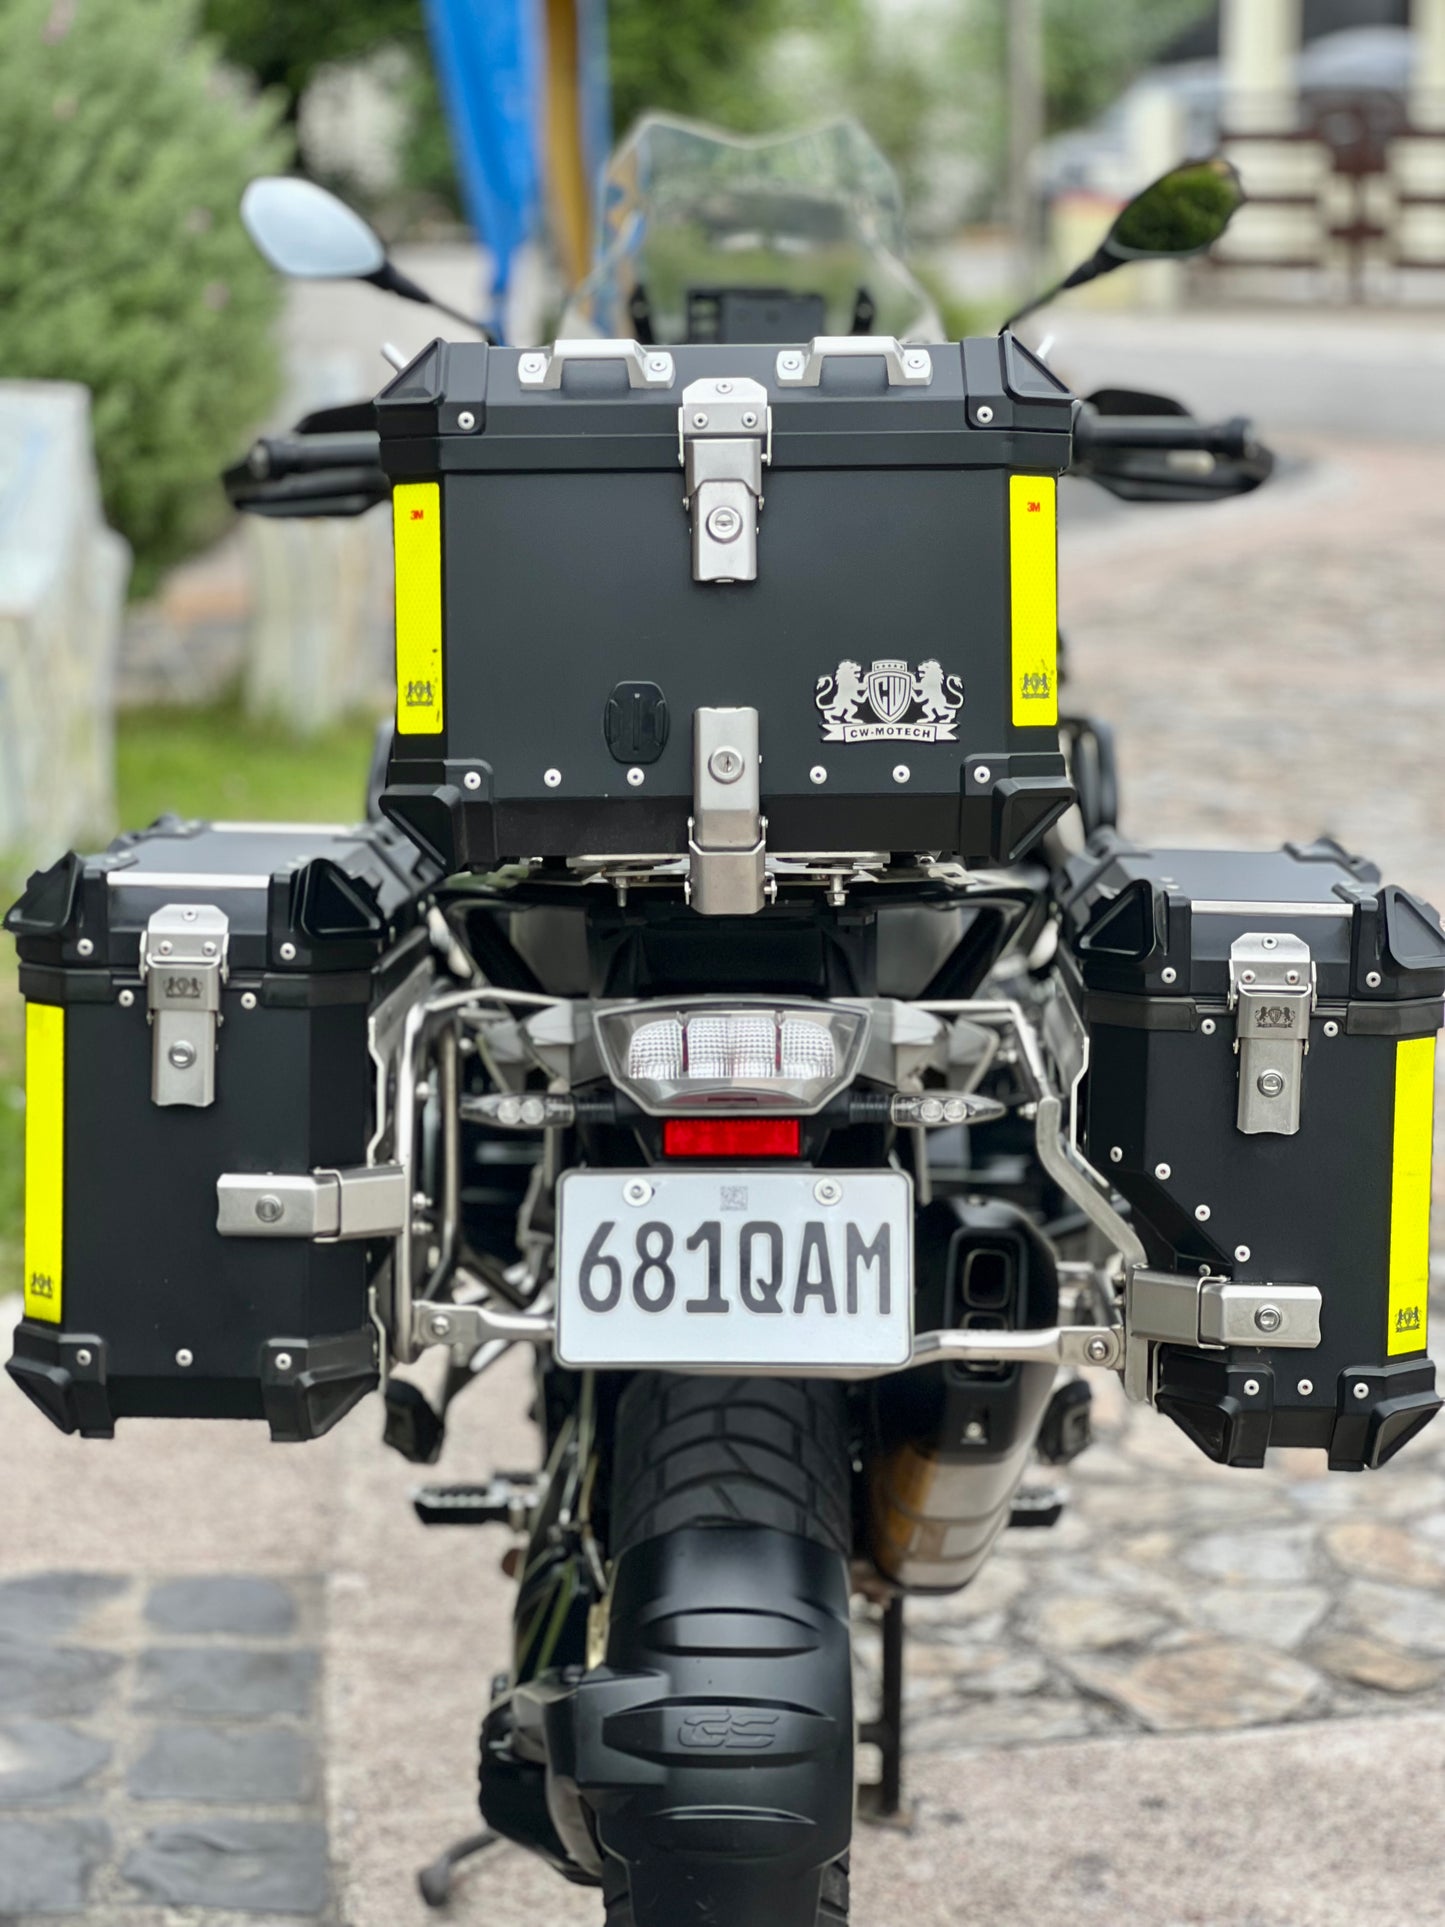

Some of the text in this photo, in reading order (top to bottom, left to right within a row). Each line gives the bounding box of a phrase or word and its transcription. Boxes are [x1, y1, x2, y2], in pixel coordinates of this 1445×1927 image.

[1027, 502, 1040, 512] 3M
[410, 510, 424, 520] 3M
[850, 727, 931, 738] CW-MOTECH
[578, 1221, 891, 1314] 681QAM
[678, 1711, 780, 1749] GS
